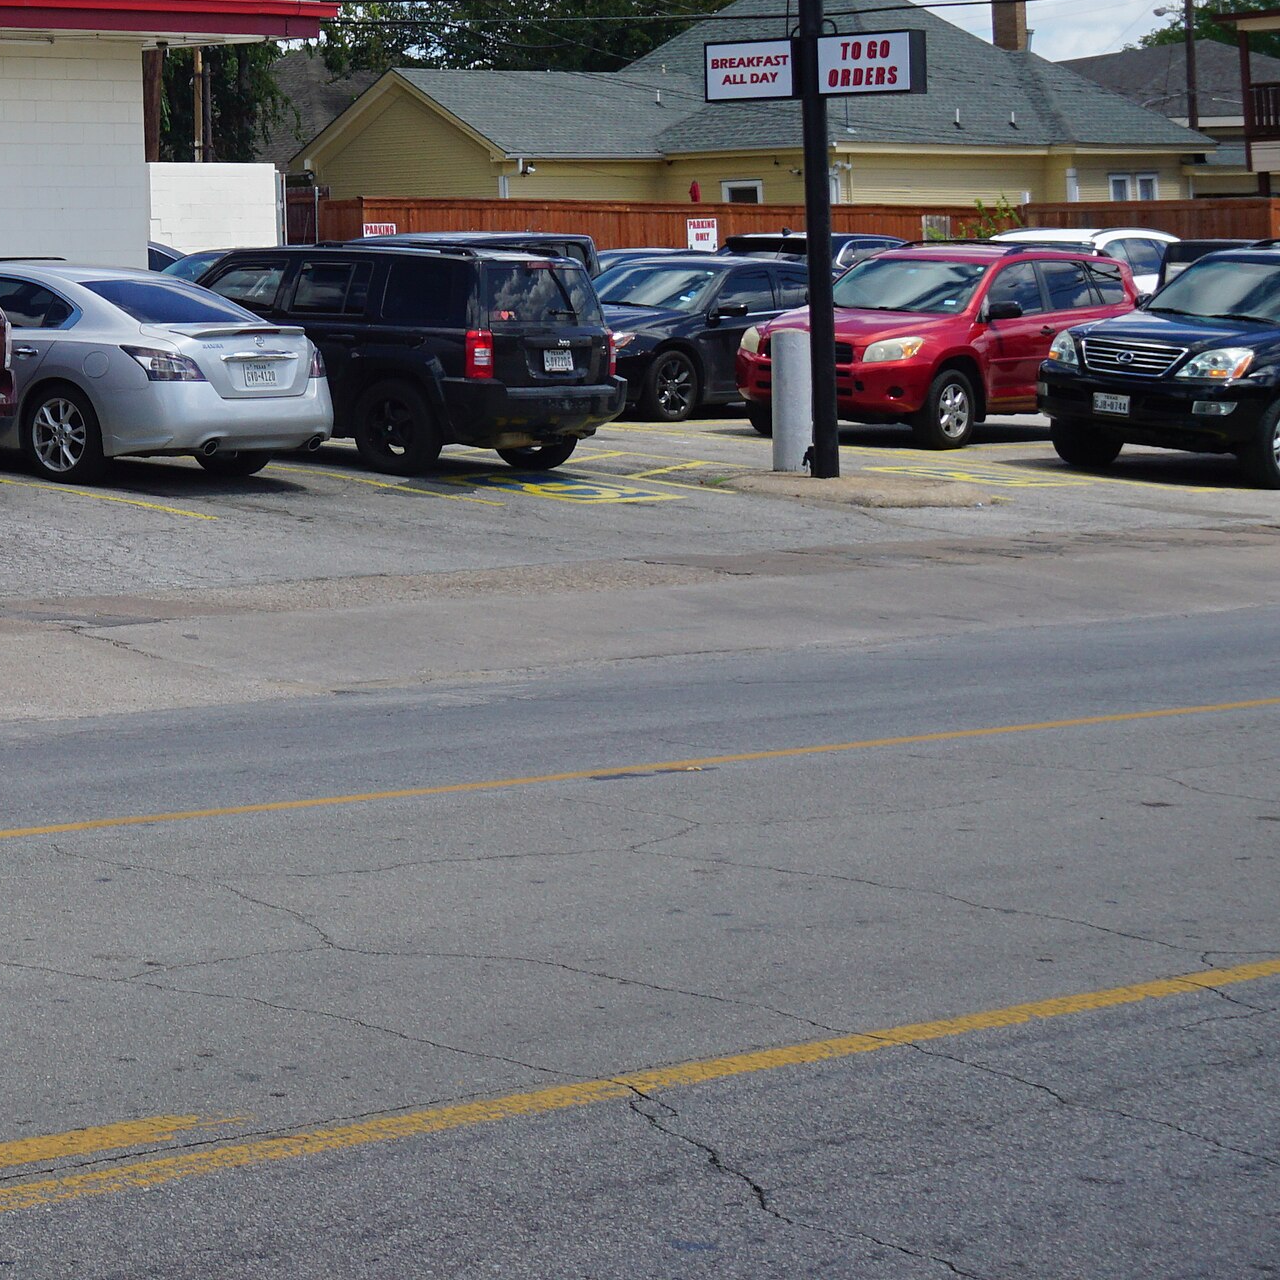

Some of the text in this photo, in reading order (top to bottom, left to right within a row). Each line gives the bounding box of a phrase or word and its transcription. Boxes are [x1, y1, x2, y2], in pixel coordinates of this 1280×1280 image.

[840, 39, 891, 61] TO GO
[710, 54, 789, 70] BREAKFAST
[721, 72, 779, 86] ALL DAY
[828, 66, 898, 88] ORDERS
[365, 224, 394, 236] PARKING
[688, 220, 715, 229] PARKING
[695, 232, 710, 241] ONLY
